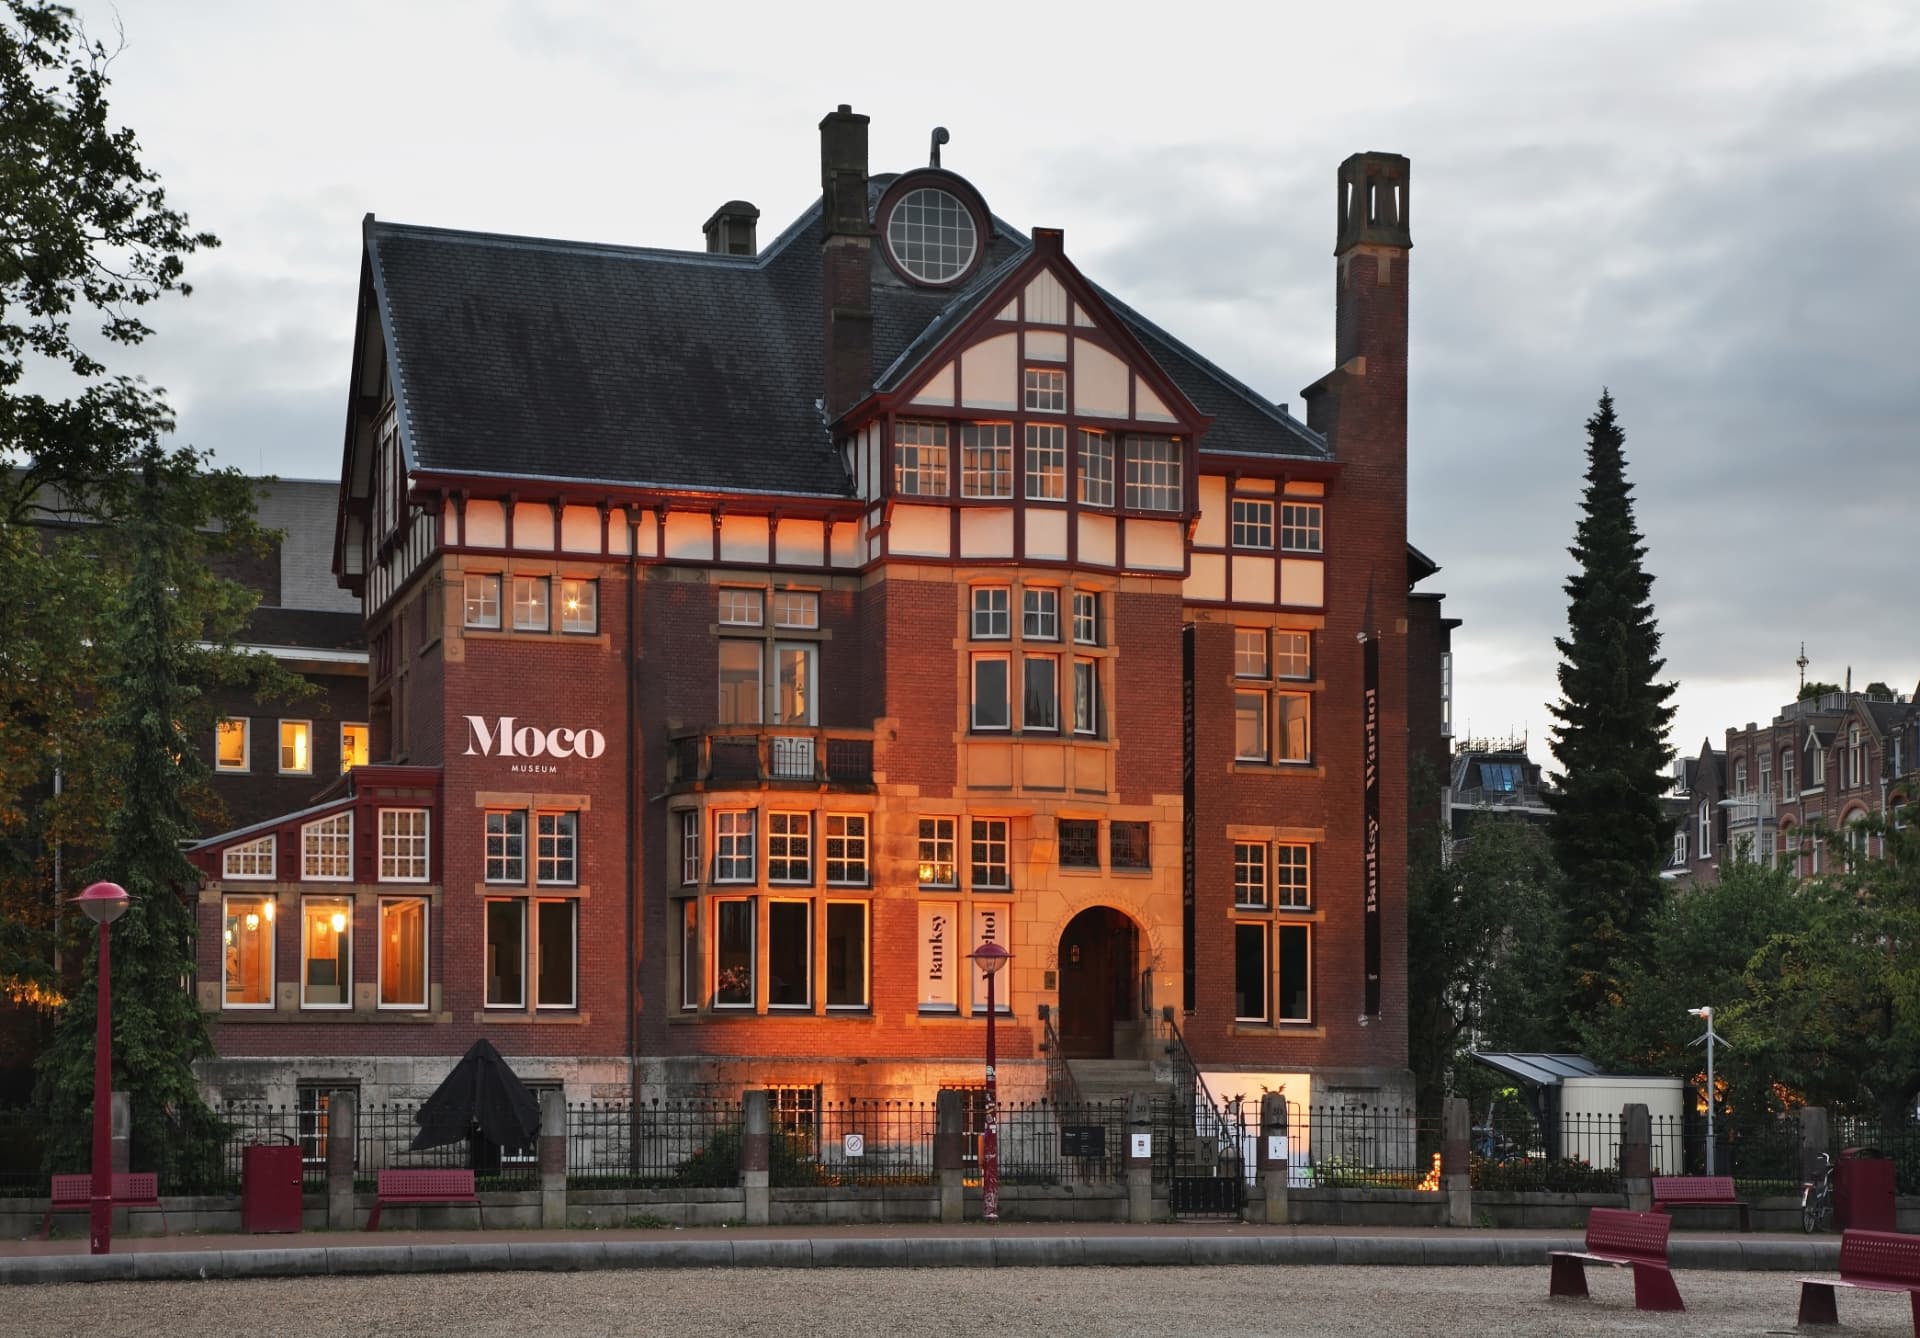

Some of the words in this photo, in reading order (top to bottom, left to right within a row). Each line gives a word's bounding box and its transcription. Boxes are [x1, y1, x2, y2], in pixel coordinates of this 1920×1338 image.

[461, 715, 606, 759] Moco
[511, 764, 557, 774] MUSEUM
[1366, 688, 1376, 791] Warhol
[1366, 815, 1379, 913] Banksy
[928, 915, 946, 980] Banksy
